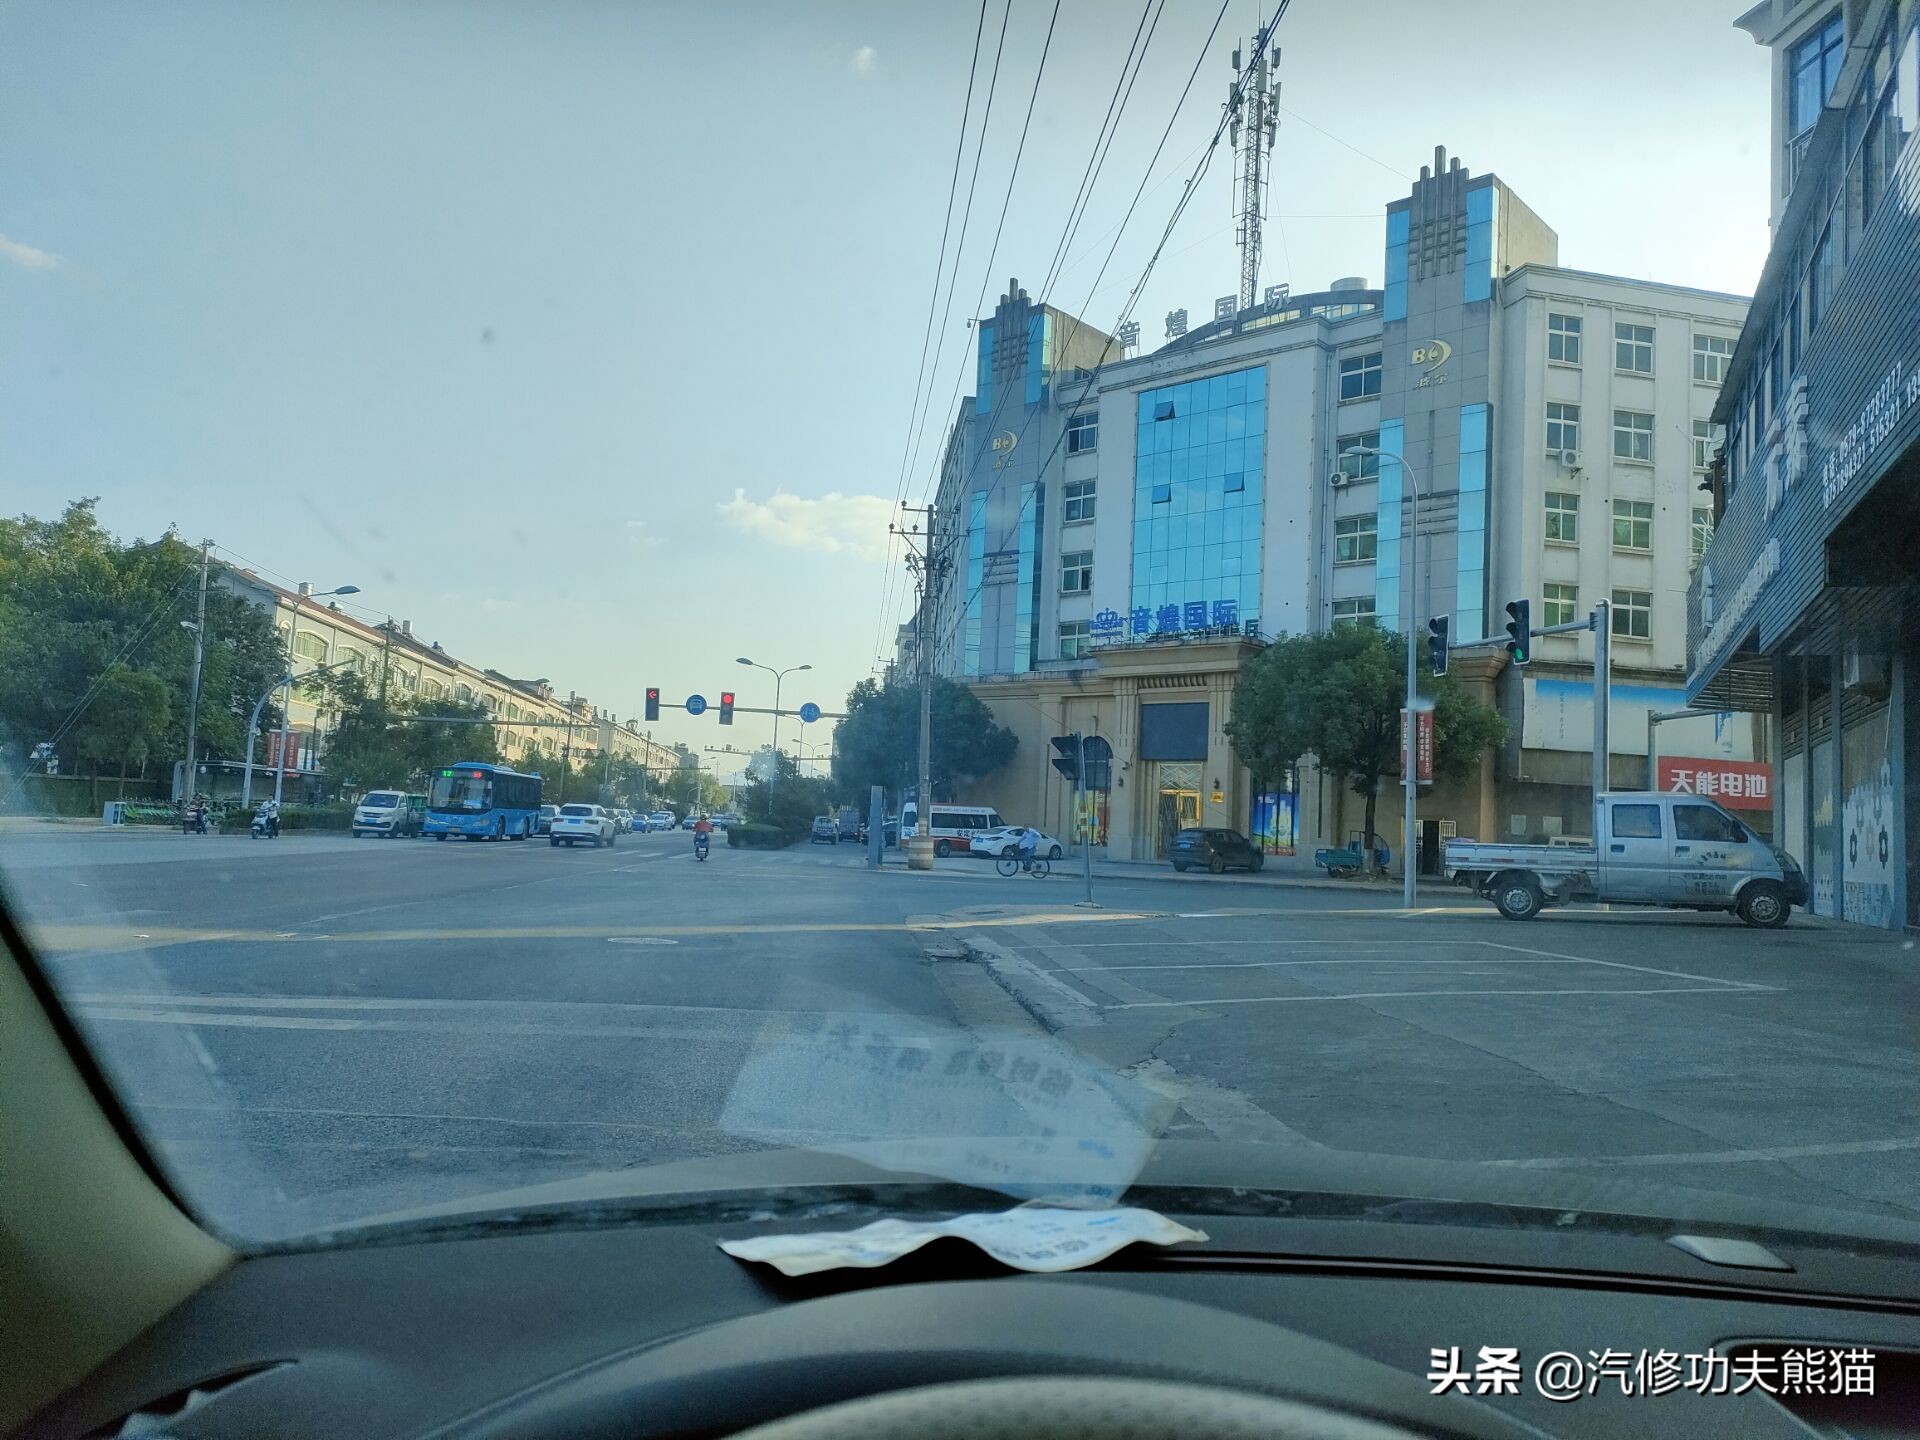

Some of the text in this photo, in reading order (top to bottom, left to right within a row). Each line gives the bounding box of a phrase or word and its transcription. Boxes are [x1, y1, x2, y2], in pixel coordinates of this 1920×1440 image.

[1119, 283, 1292, 350] 音煌国际
[1869, 396, 1901, 453] 515321
[1131, 599, 1240, 635] 音煌国际
[1671, 769, 1767, 799] 天能电池
